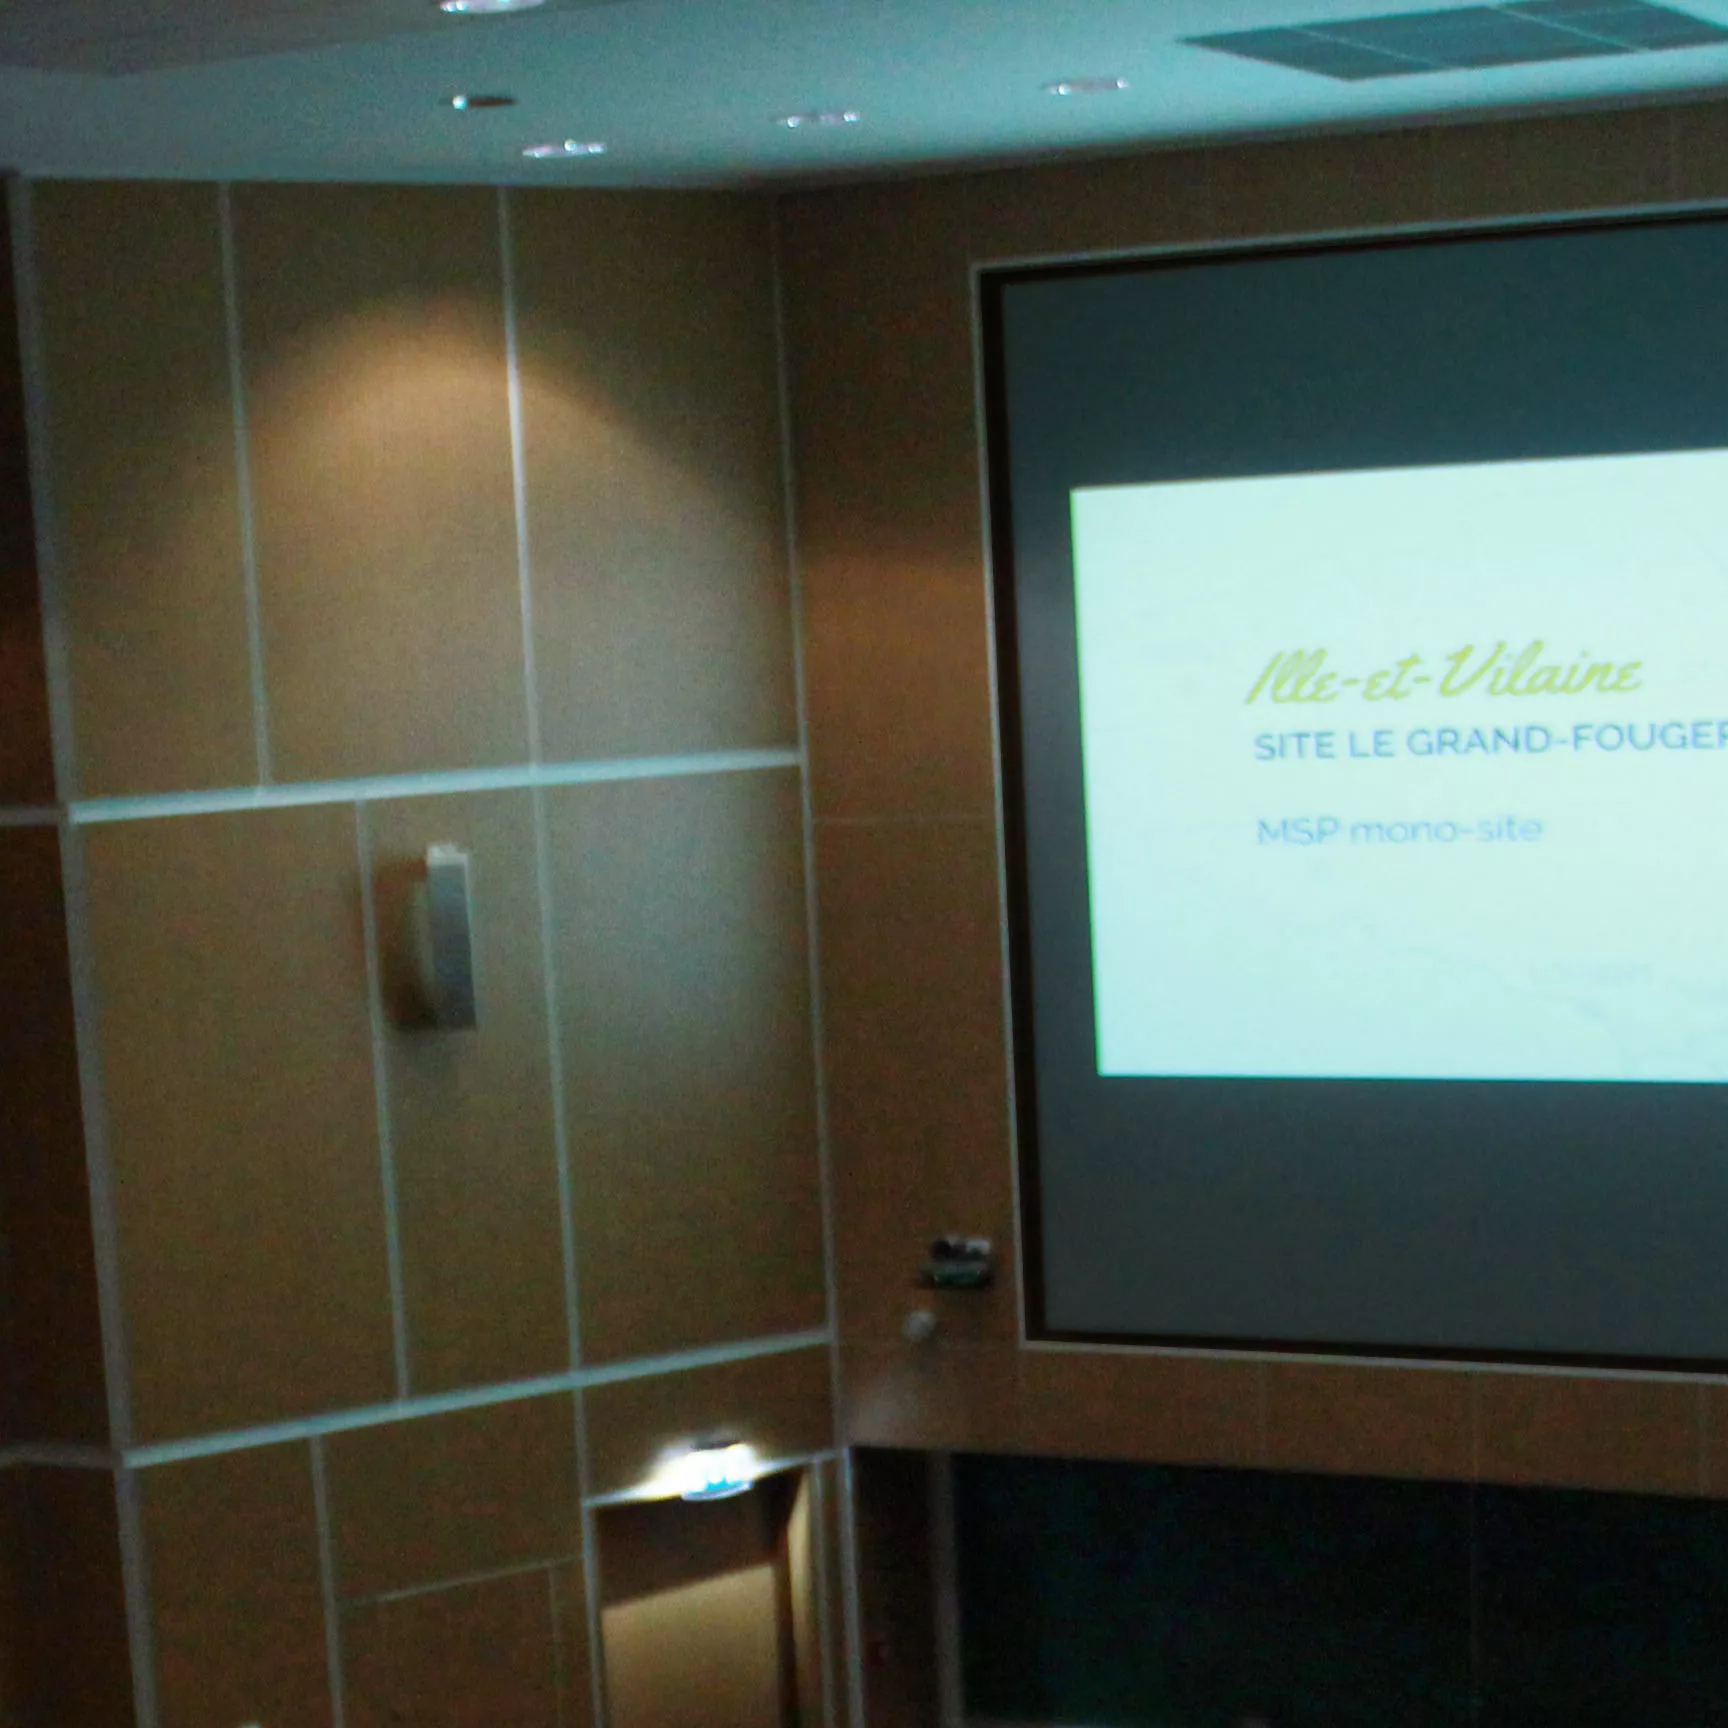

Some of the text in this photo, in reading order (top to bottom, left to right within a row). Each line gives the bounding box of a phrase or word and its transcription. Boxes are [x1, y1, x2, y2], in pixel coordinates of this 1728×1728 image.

[1243, 638, 1644, 705] Ille-et-Vilaine
[1253, 729, 1336, 761] SITE
[1348, 727, 1396, 758] LE
[1256, 814, 1544, 846] MSP mono-site
